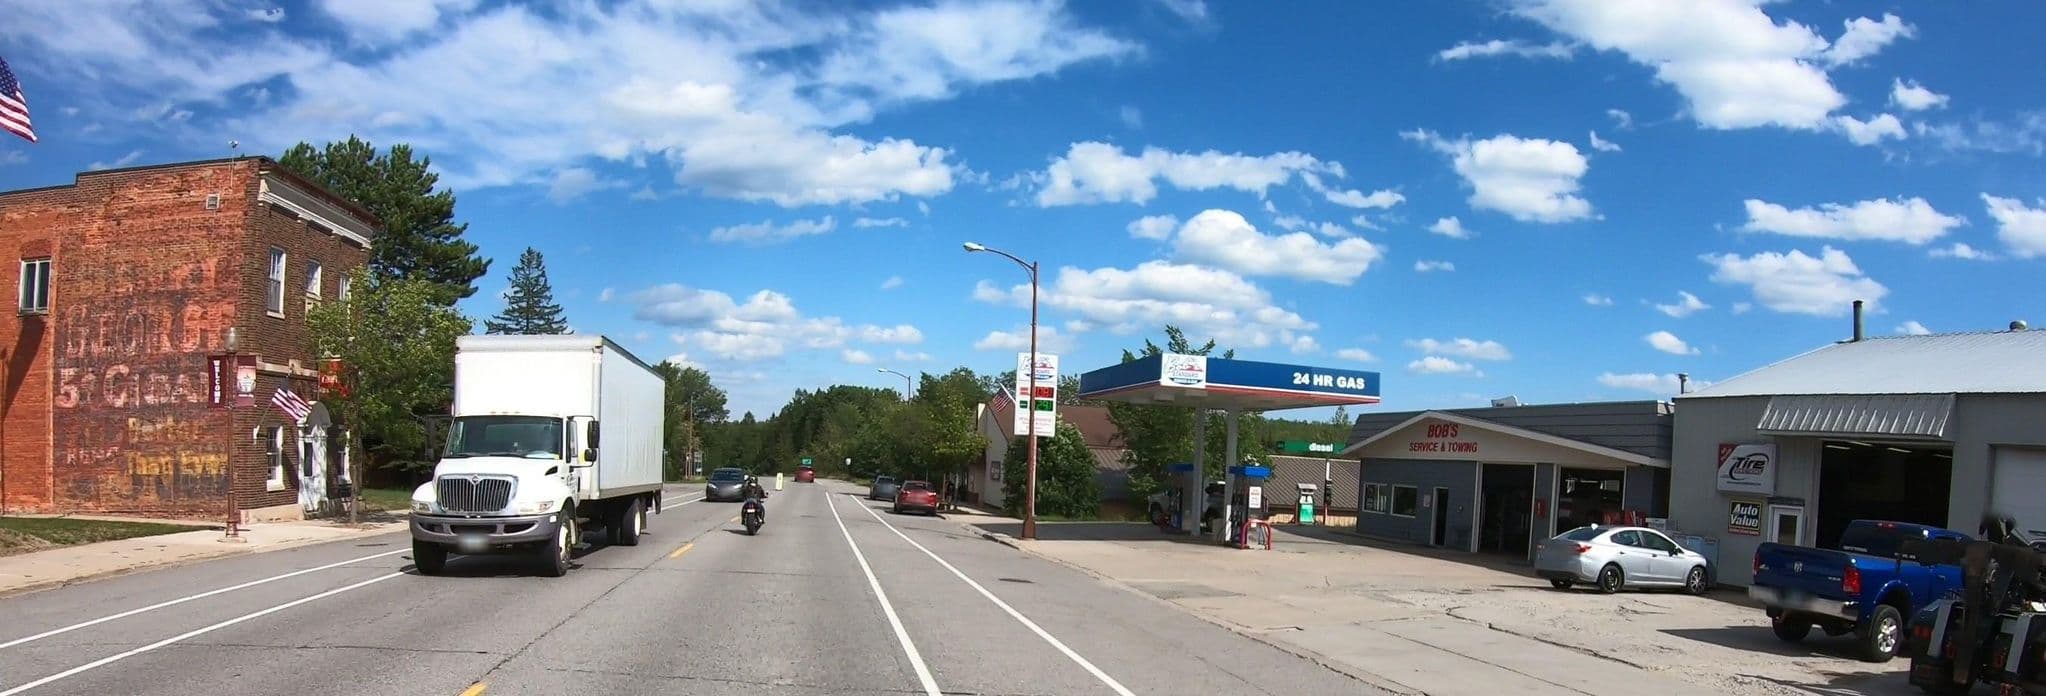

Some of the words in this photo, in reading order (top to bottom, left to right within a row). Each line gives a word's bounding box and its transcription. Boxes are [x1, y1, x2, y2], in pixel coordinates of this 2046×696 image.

[1293, 372, 1310, 385] 24
[1312, 374, 1333, 387] HR
[1336, 376, 1365, 390] GAS
[1428, 424, 1458, 438] BOB'S
[1308, 442, 1333, 452] diesel
[1409, 441, 1439, 452] SERVICE
[1441, 442, 1446, 452] &
[1448, 442, 1478, 453] TOWING
[1735, 457, 1765, 469] Tire
[1732, 503, 1758, 516] Auto
[1730, 514, 1759, 527] Value
